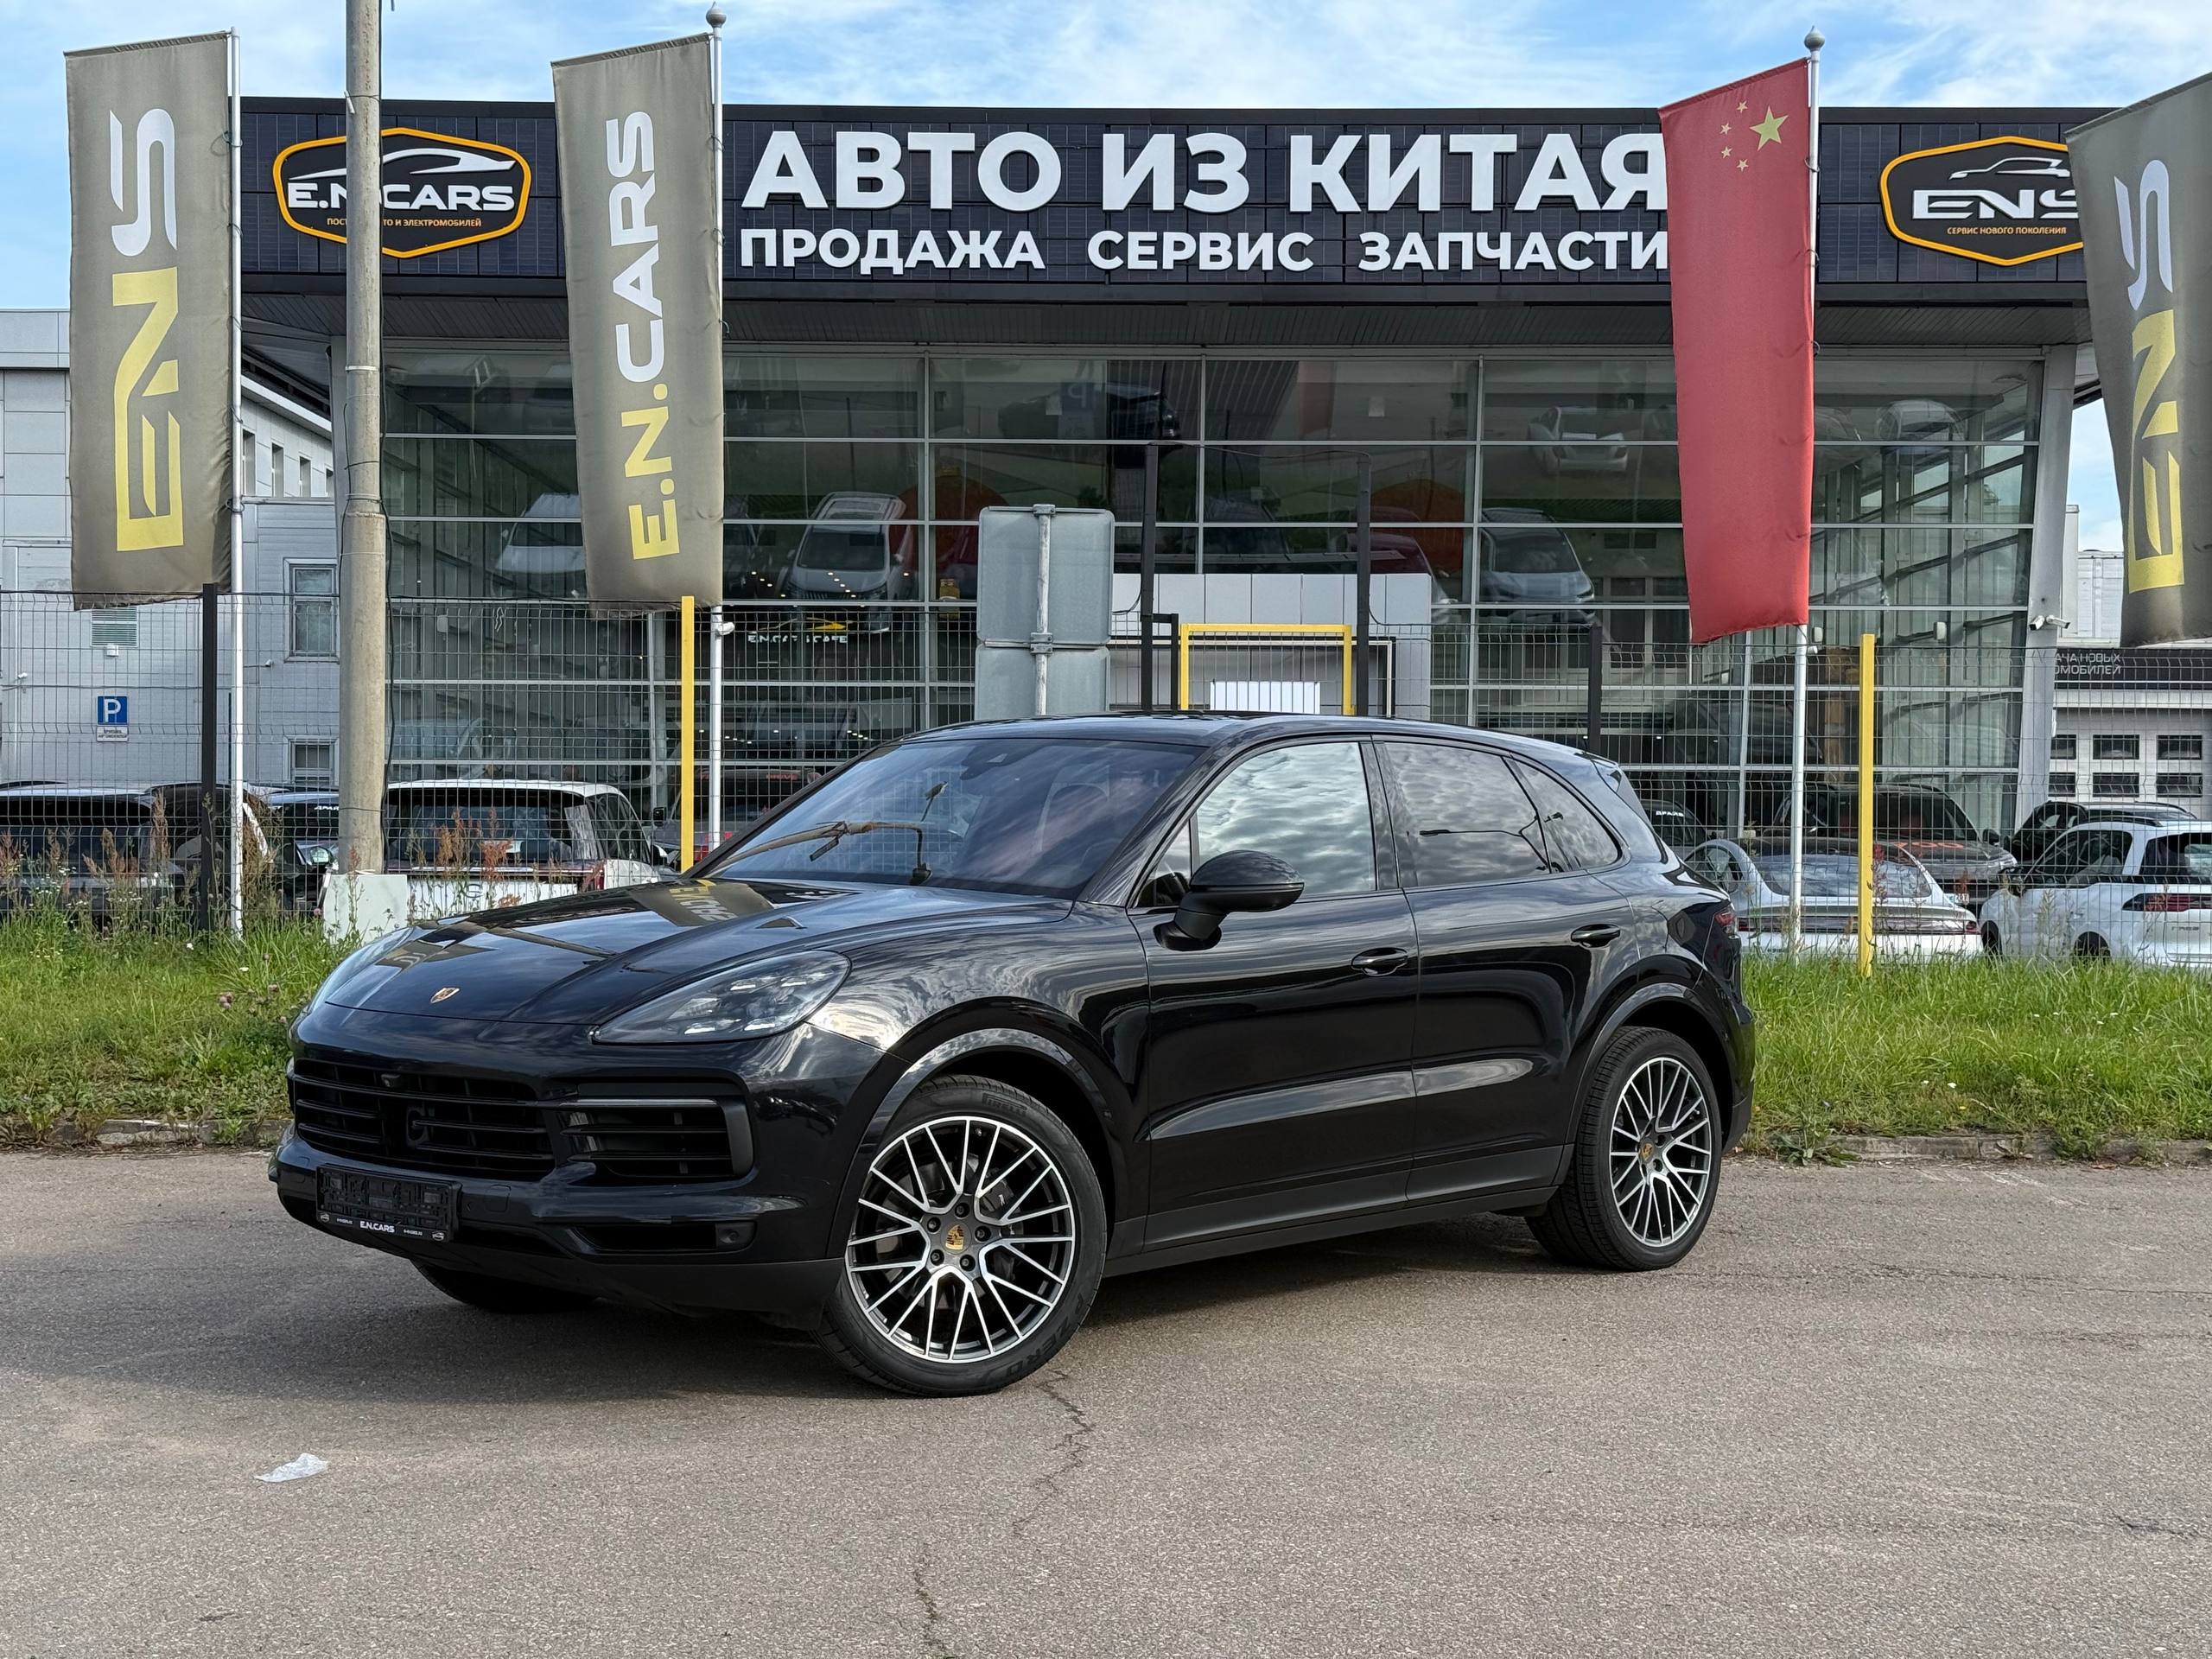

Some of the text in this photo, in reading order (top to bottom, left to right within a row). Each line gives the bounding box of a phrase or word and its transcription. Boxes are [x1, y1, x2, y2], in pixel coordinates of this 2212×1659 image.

[741, 130, 1669, 213] АВТО ИЗ КИТАЯ
[288, 182, 515, 212] E.CARS
[403, 218, 482, 227] ЭЛЕКТРОМОБИЛЕЙ
[741, 228, 1669, 276] ПРОДАЖА СЕРВИС ЗАПЧАСТИ
[110, 108, 184, 551] ENS
[607, 111, 680, 560] E.N.CARS
[2080, 652, 2120, 663] НОВЫХ
[104, 698, 122, 722] P
[359, 1220, 395, 1233] E.N.CARS
